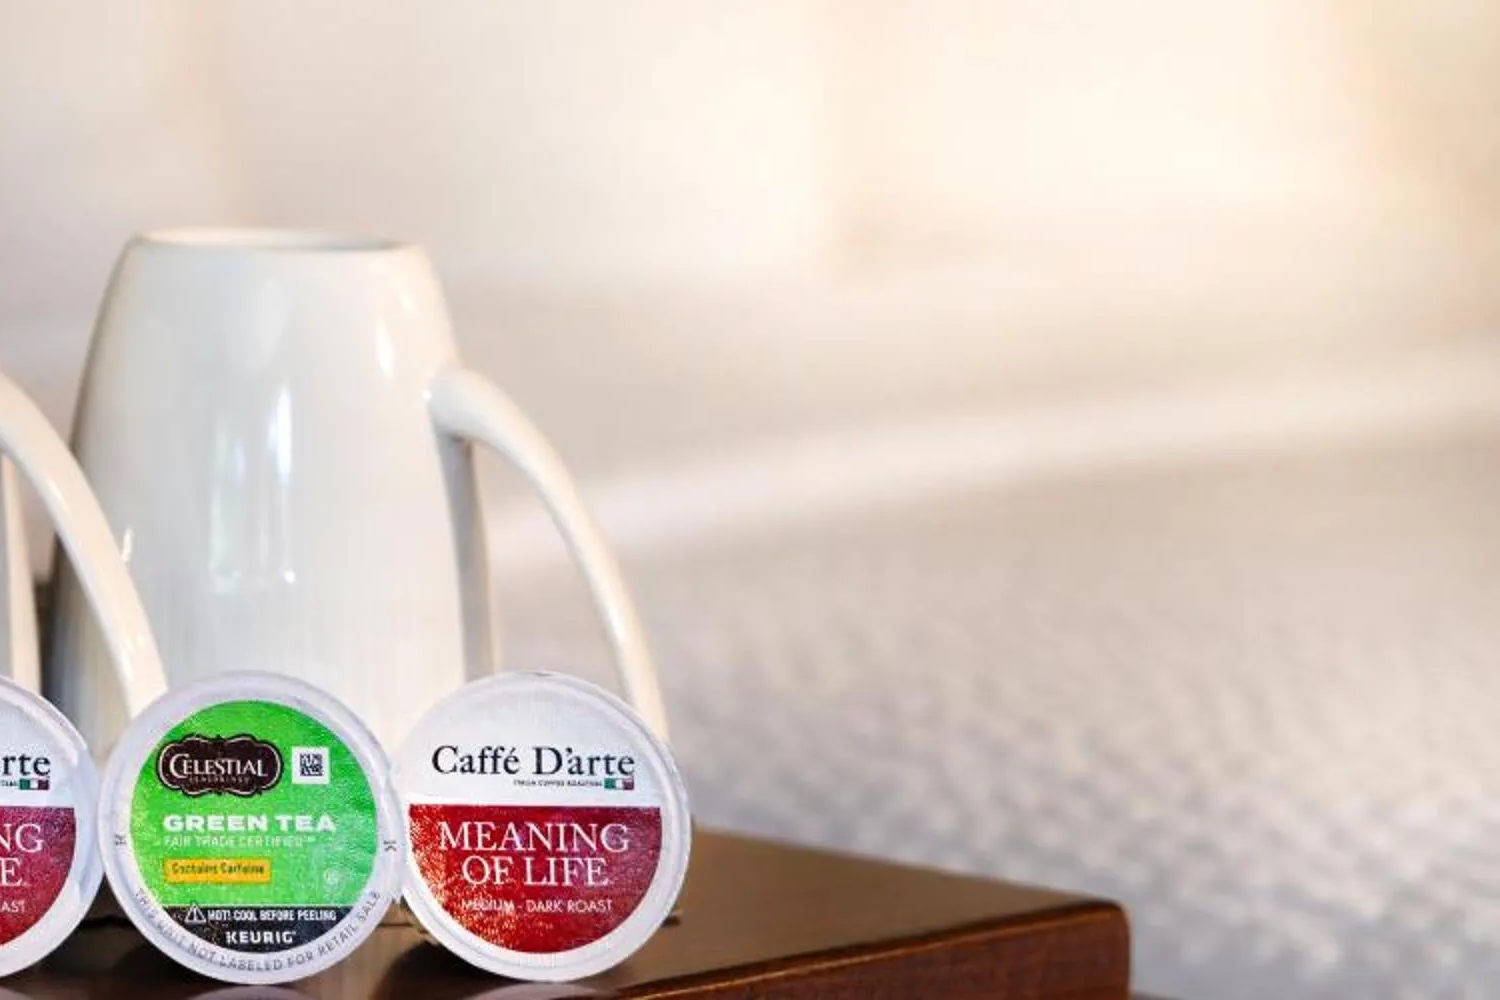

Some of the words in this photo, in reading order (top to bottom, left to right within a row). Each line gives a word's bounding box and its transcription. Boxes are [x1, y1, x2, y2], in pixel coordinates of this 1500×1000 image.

[169, 753, 268, 778] CELESTIAL
[431, 745, 520, 774] Caffé
[532, 747, 635, 776] D'arte
[163, 814, 269, 832] GREEN
[274, 814, 337, 832] TEA
[164, 835, 191, 847] FAIR
[194, 835, 236, 848] TRADE
[437, 820, 630, 853] MEANING
[462, 855, 513, 885] OF
[523, 856, 609, 887] LIFE
[207, 909, 231, 921] HOT!
[233, 909, 257, 921] COOL
[260, 909, 295, 921] BEFORE
[297, 909, 337, 921] PEELING
[462, 898, 515, 912] MEDIUM
[526, 899, 563, 913] DARK
[567, 899, 612, 913] ROAST
[187, 942, 217, 963] NOT
[287, 950, 314, 969] FOR
[317, 922, 358, 957] RETAIL
[356, 888, 381, 921] SALE
